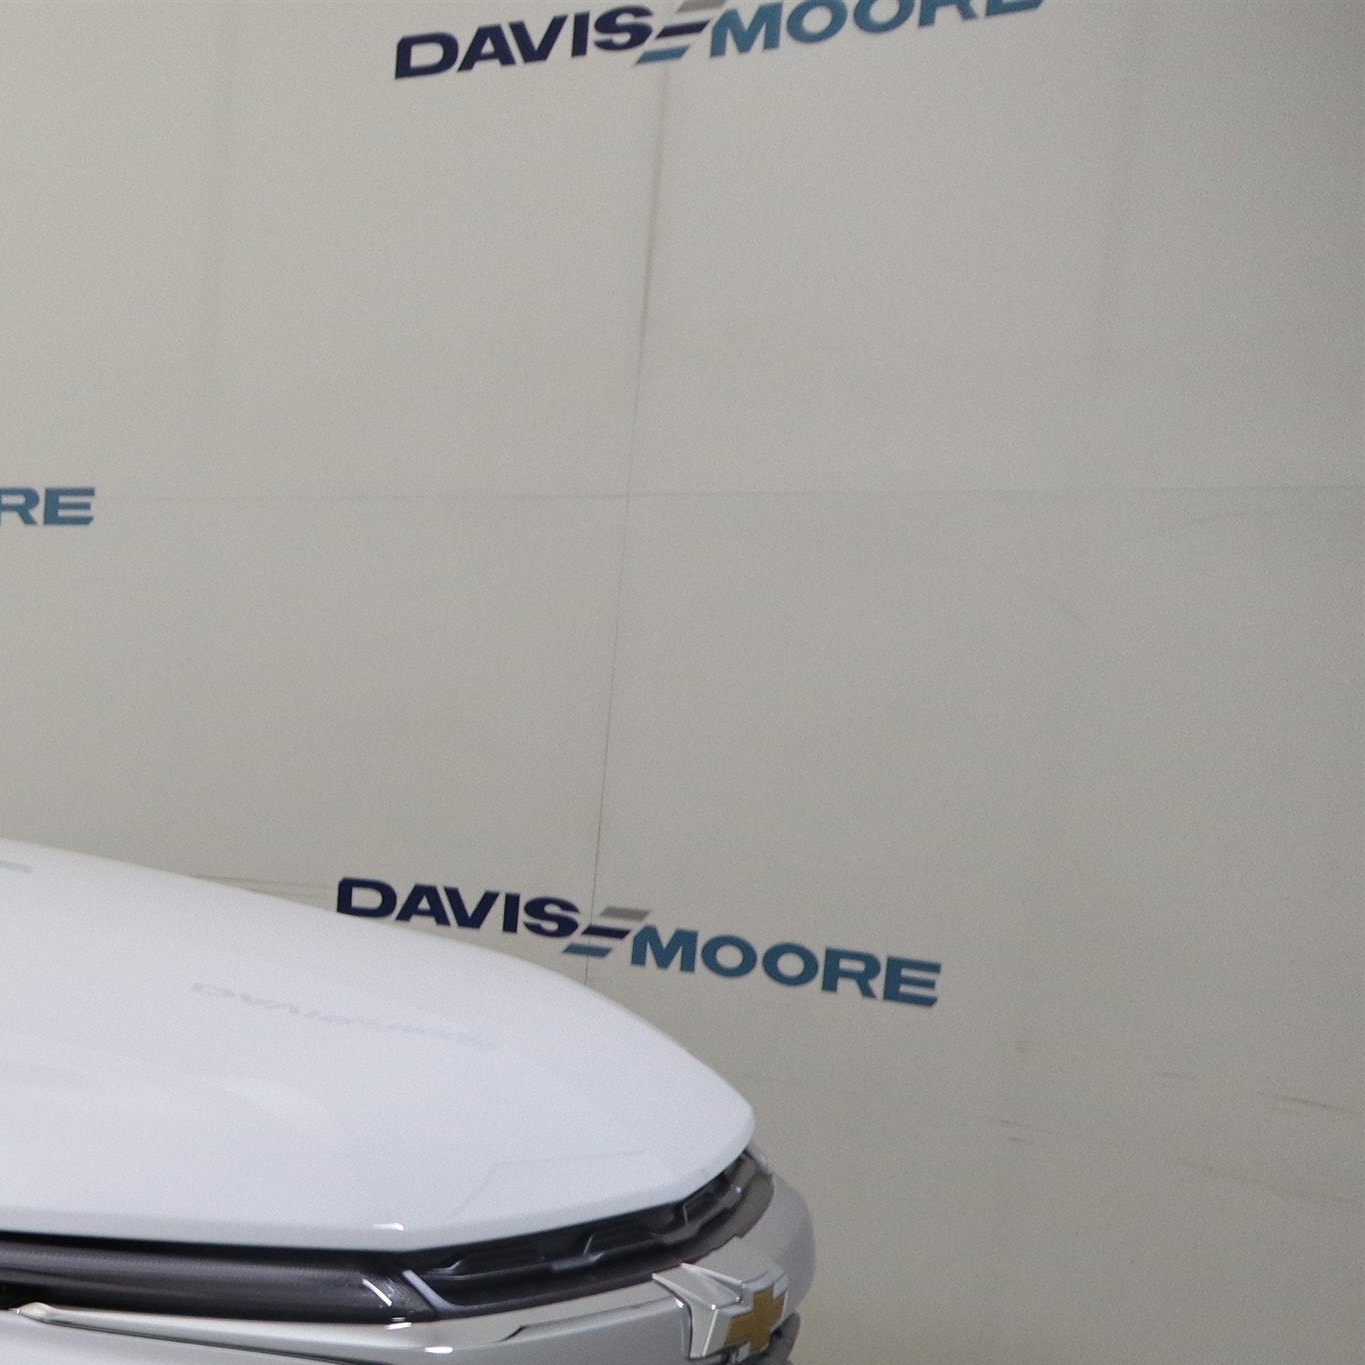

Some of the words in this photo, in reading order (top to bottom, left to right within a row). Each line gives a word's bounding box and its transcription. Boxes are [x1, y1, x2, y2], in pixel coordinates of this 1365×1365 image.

[394, 5, 655, 79] DAVIS
[709, 0, 1045, 58] MOOR
[334, 875, 583, 941] DAVIS
[628, 923, 944, 1011] MOORE
